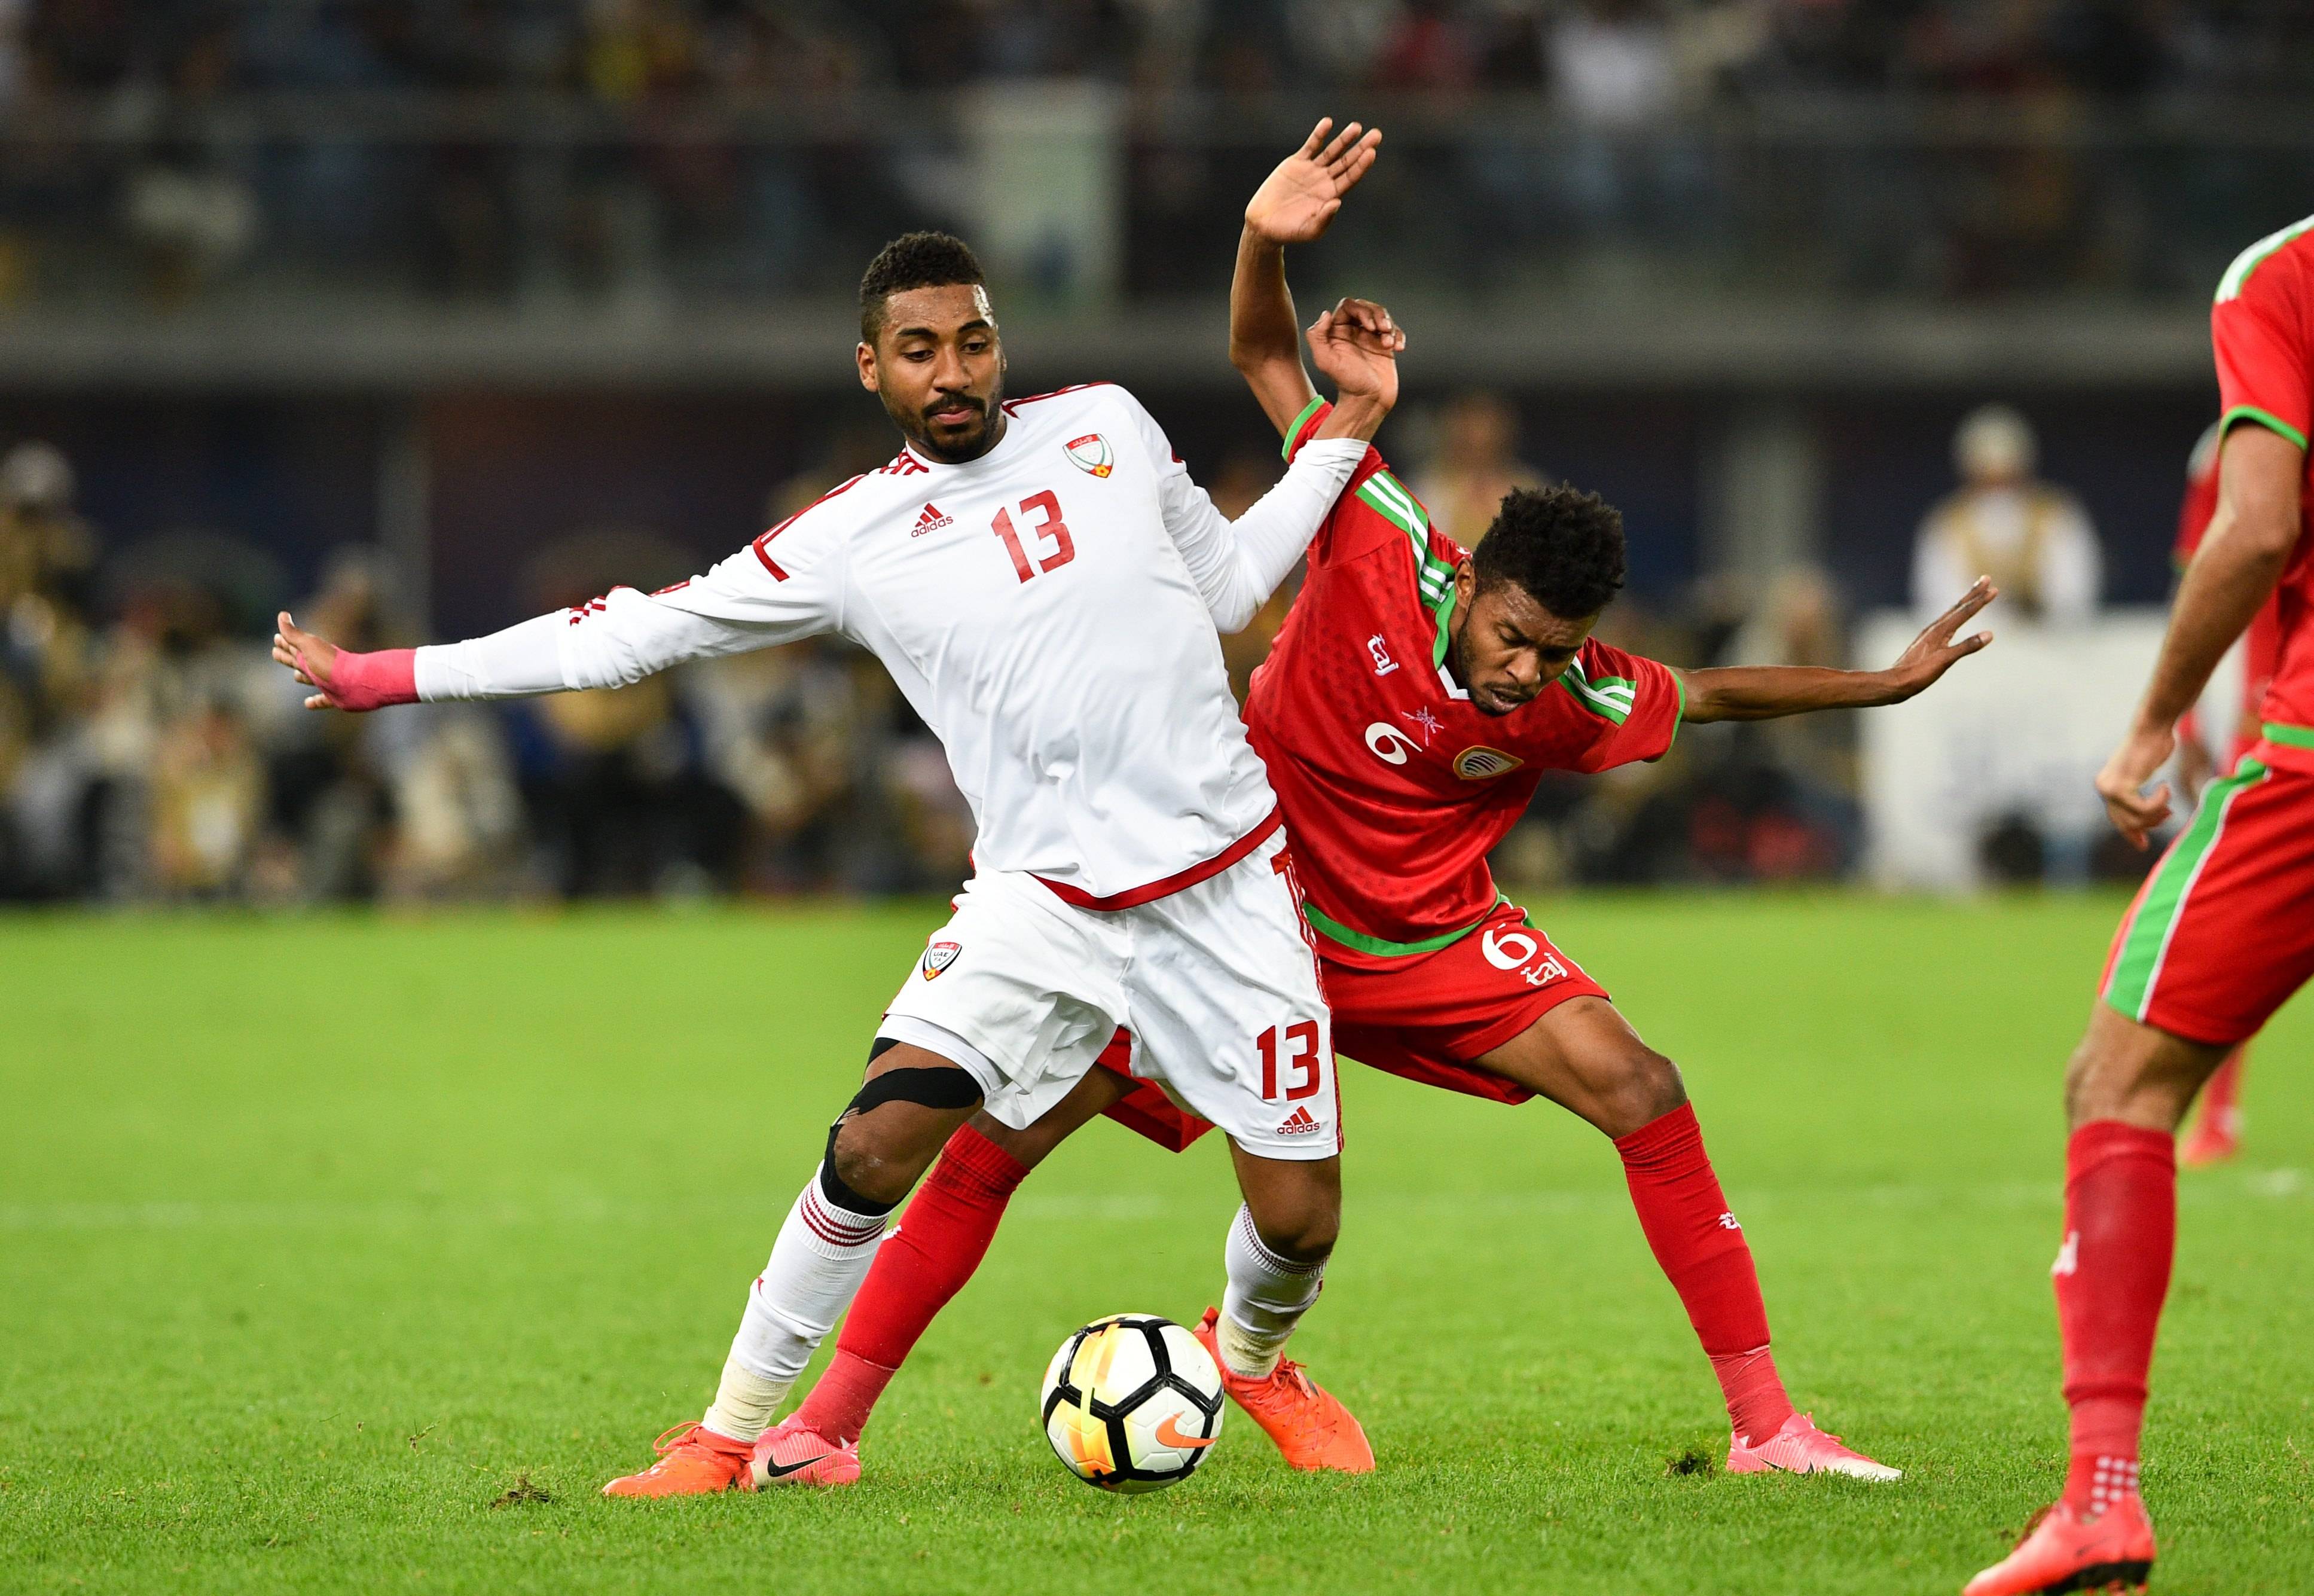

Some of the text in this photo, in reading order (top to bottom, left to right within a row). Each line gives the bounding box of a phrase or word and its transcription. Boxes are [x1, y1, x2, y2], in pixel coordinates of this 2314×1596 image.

[911, 515, 954, 538] adidas
[991, 490, 1075, 584] 13
[1364, 722, 1422, 765] 6
[1482, 923, 1538, 970] 6
[1257, 1020, 1321, 1101] 13
[1277, 1122, 1320, 1134] adidas
